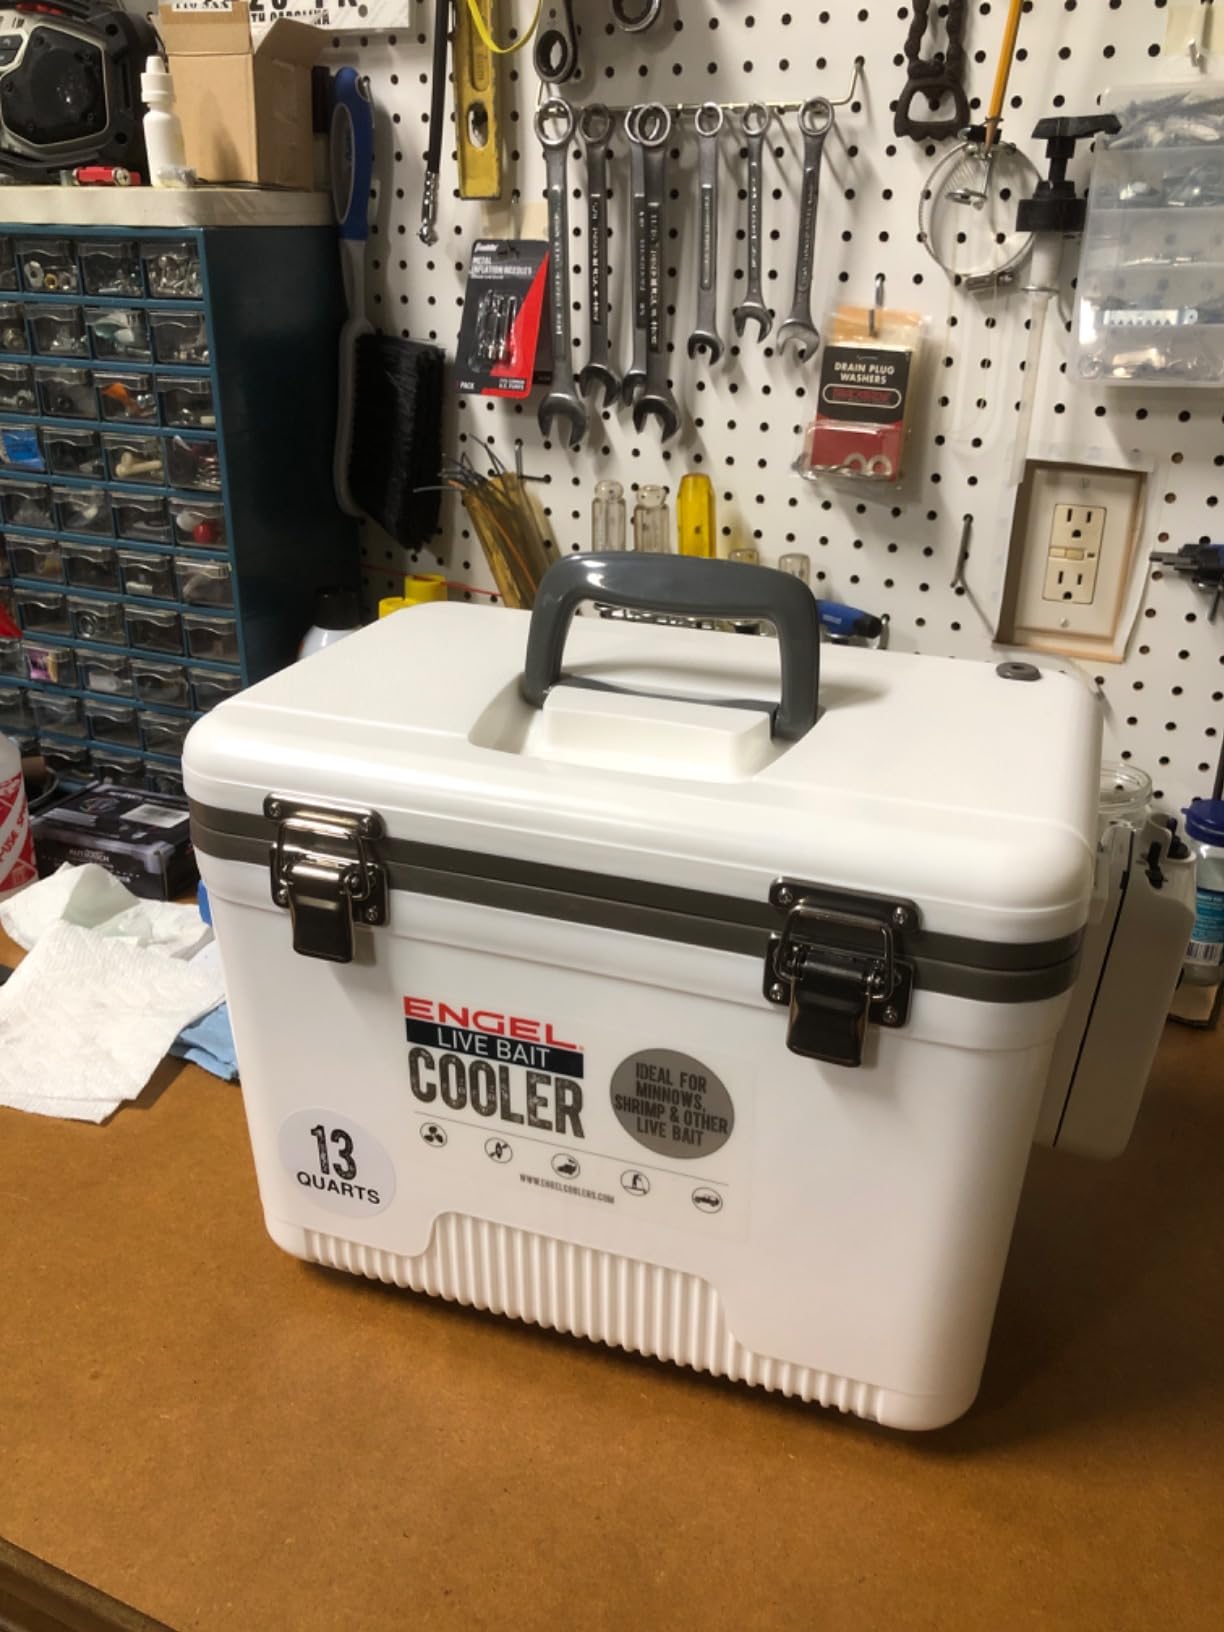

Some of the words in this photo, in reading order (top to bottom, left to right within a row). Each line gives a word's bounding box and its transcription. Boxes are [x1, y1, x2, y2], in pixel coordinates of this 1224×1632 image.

[834, 361, 866, 372] DRAIN
[869, 364, 895, 375] PLUG
[840, 372, 887, 385] WASHERS
[403, 996, 577, 1050] ENGEL
[437, 1027, 489, 1056] LIVE
[496, 1039, 550, 1068] BAIT
[408, 1046, 585, 1139] COOLER
[635, 1062, 672, 1086] IDEAL
[680, 1071, 707, 1094] FOR
[636, 1081, 706, 1113] MINNOWS,
[614, 1094, 665, 1119] SHRIMP
[670, 1106, 680, 1123] &
[683, 1109, 728, 1135] OTHER
[636, 1116, 666, 1138] LIVE
[672, 1124, 704, 1147] BAIT
[310, 1124, 357, 1181] 13
[296, 1171, 381, 1205] QUARTS
